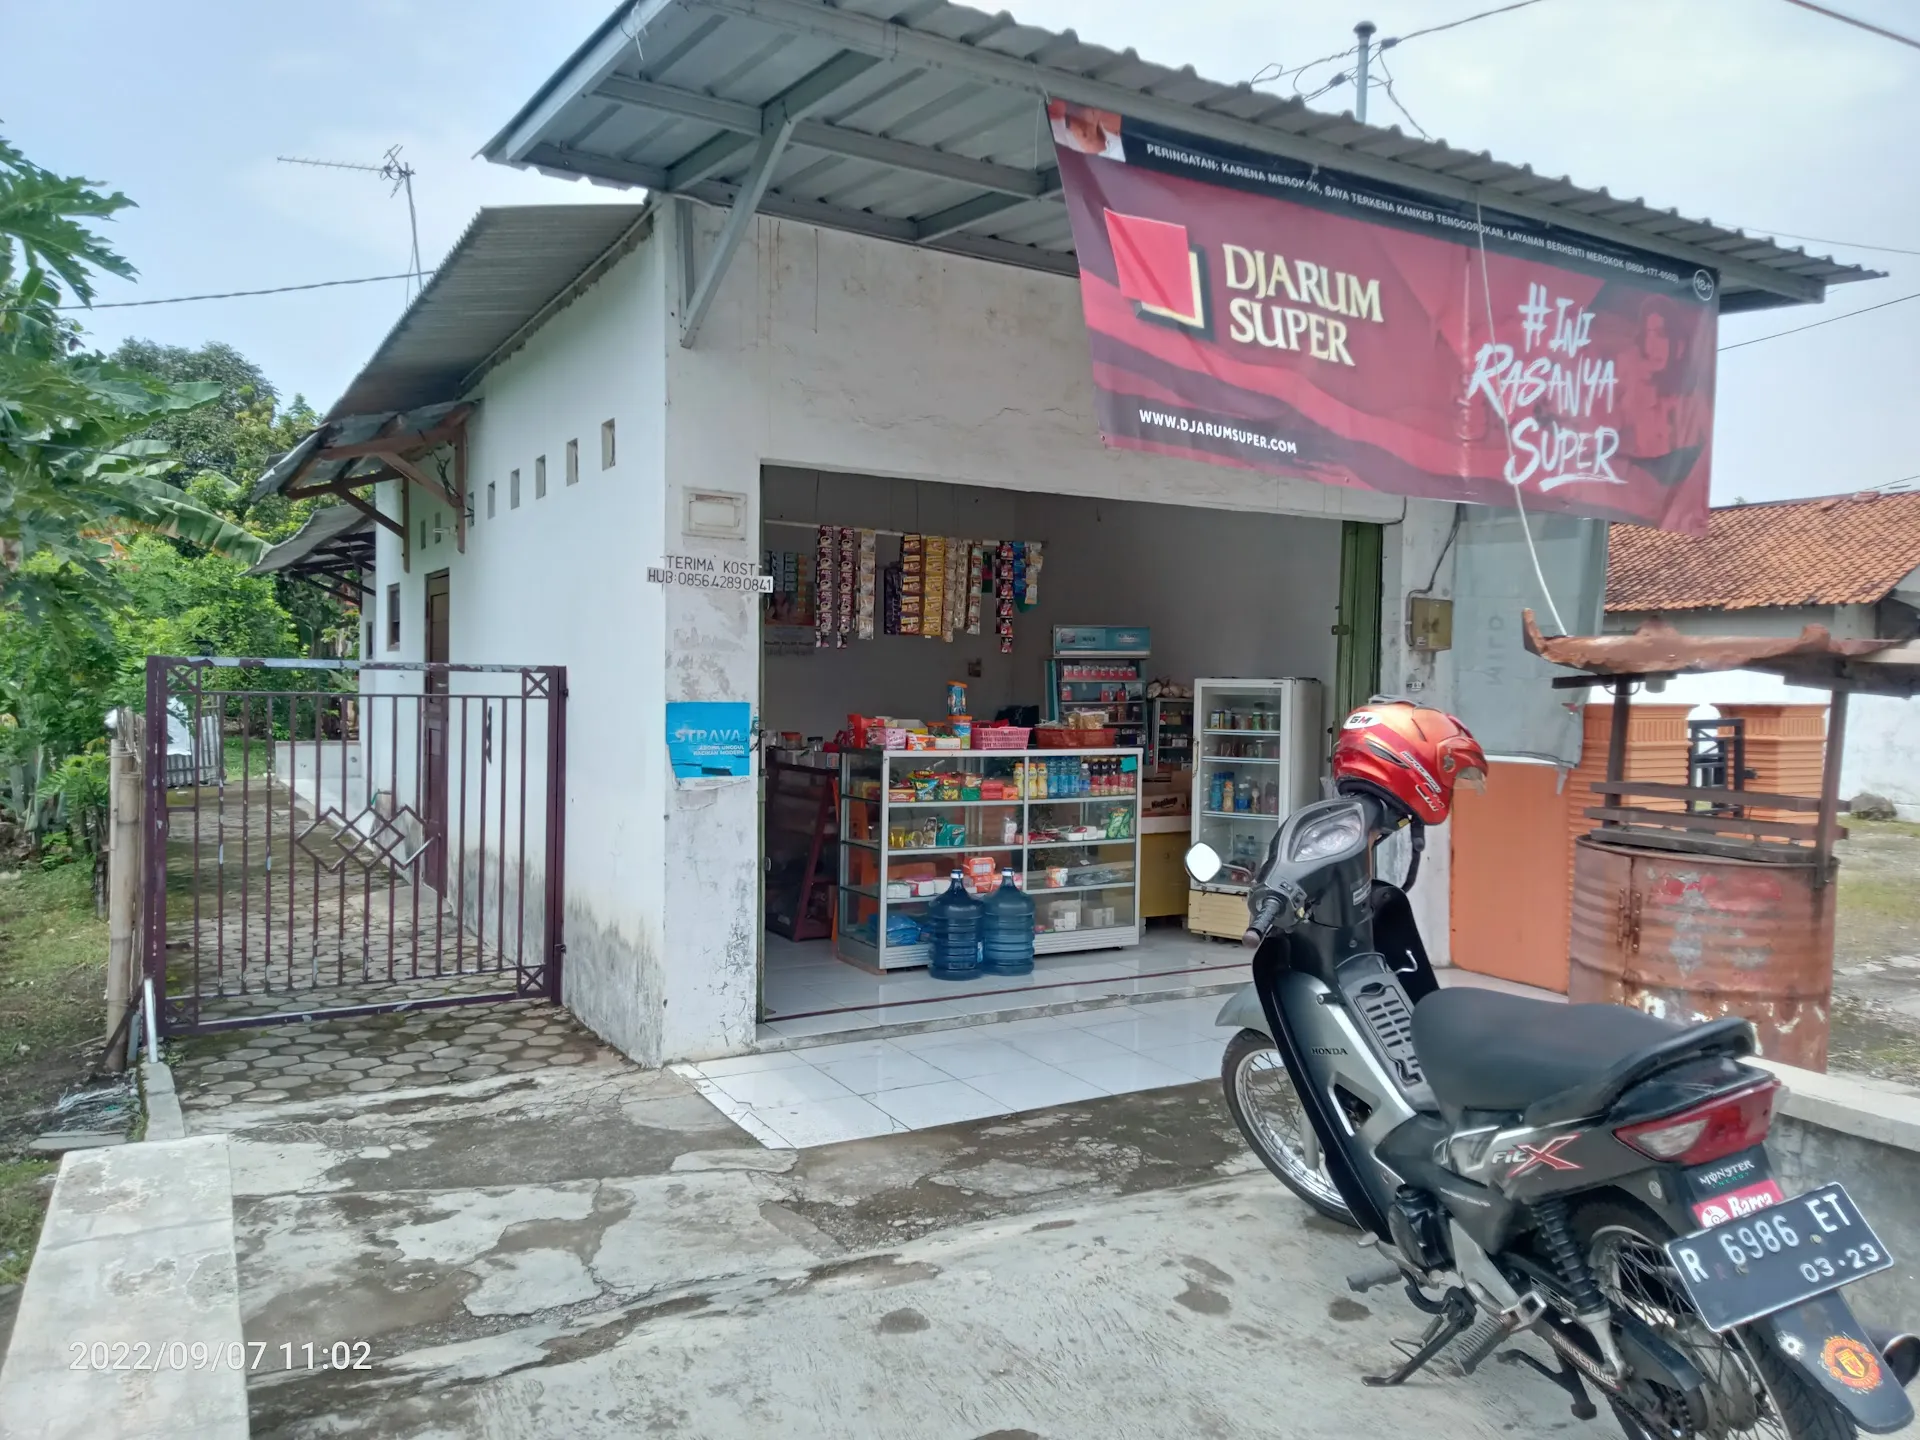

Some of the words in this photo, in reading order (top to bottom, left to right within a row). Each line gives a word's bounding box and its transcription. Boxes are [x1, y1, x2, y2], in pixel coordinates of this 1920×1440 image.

[1221, 162, 1266, 181] KARENA
[1324, 184, 1350, 202] SAYA
[1350, 192, 1395, 213] TERKENA
[1397, 204, 1434, 222] KANKER
[1507, 230, 1545, 248] LAYANAN
[1547, 240, 1585, 258] BERHENTI
[1586, 251, 1625, 269] MEROKOK
[1222, 242, 1385, 323] DJARUM
[1230, 297, 1356, 367] SUPER
[1139, 408, 1298, 455] WWW.DJARUMSUPER.COM
[666, 555, 714, 572] TERIMA
[724, 560, 756, 576] KOST
[1350, 715, 1373, 724] GM
[1311, 1047, 1348, 1056] HONDA
[1698, 1160, 1755, 1186] MONSTER
[1678, 1248, 1710, 1283] R
[1718, 1213, 1800, 1266] 6986
[1804, 1193, 1851, 1234] ET
